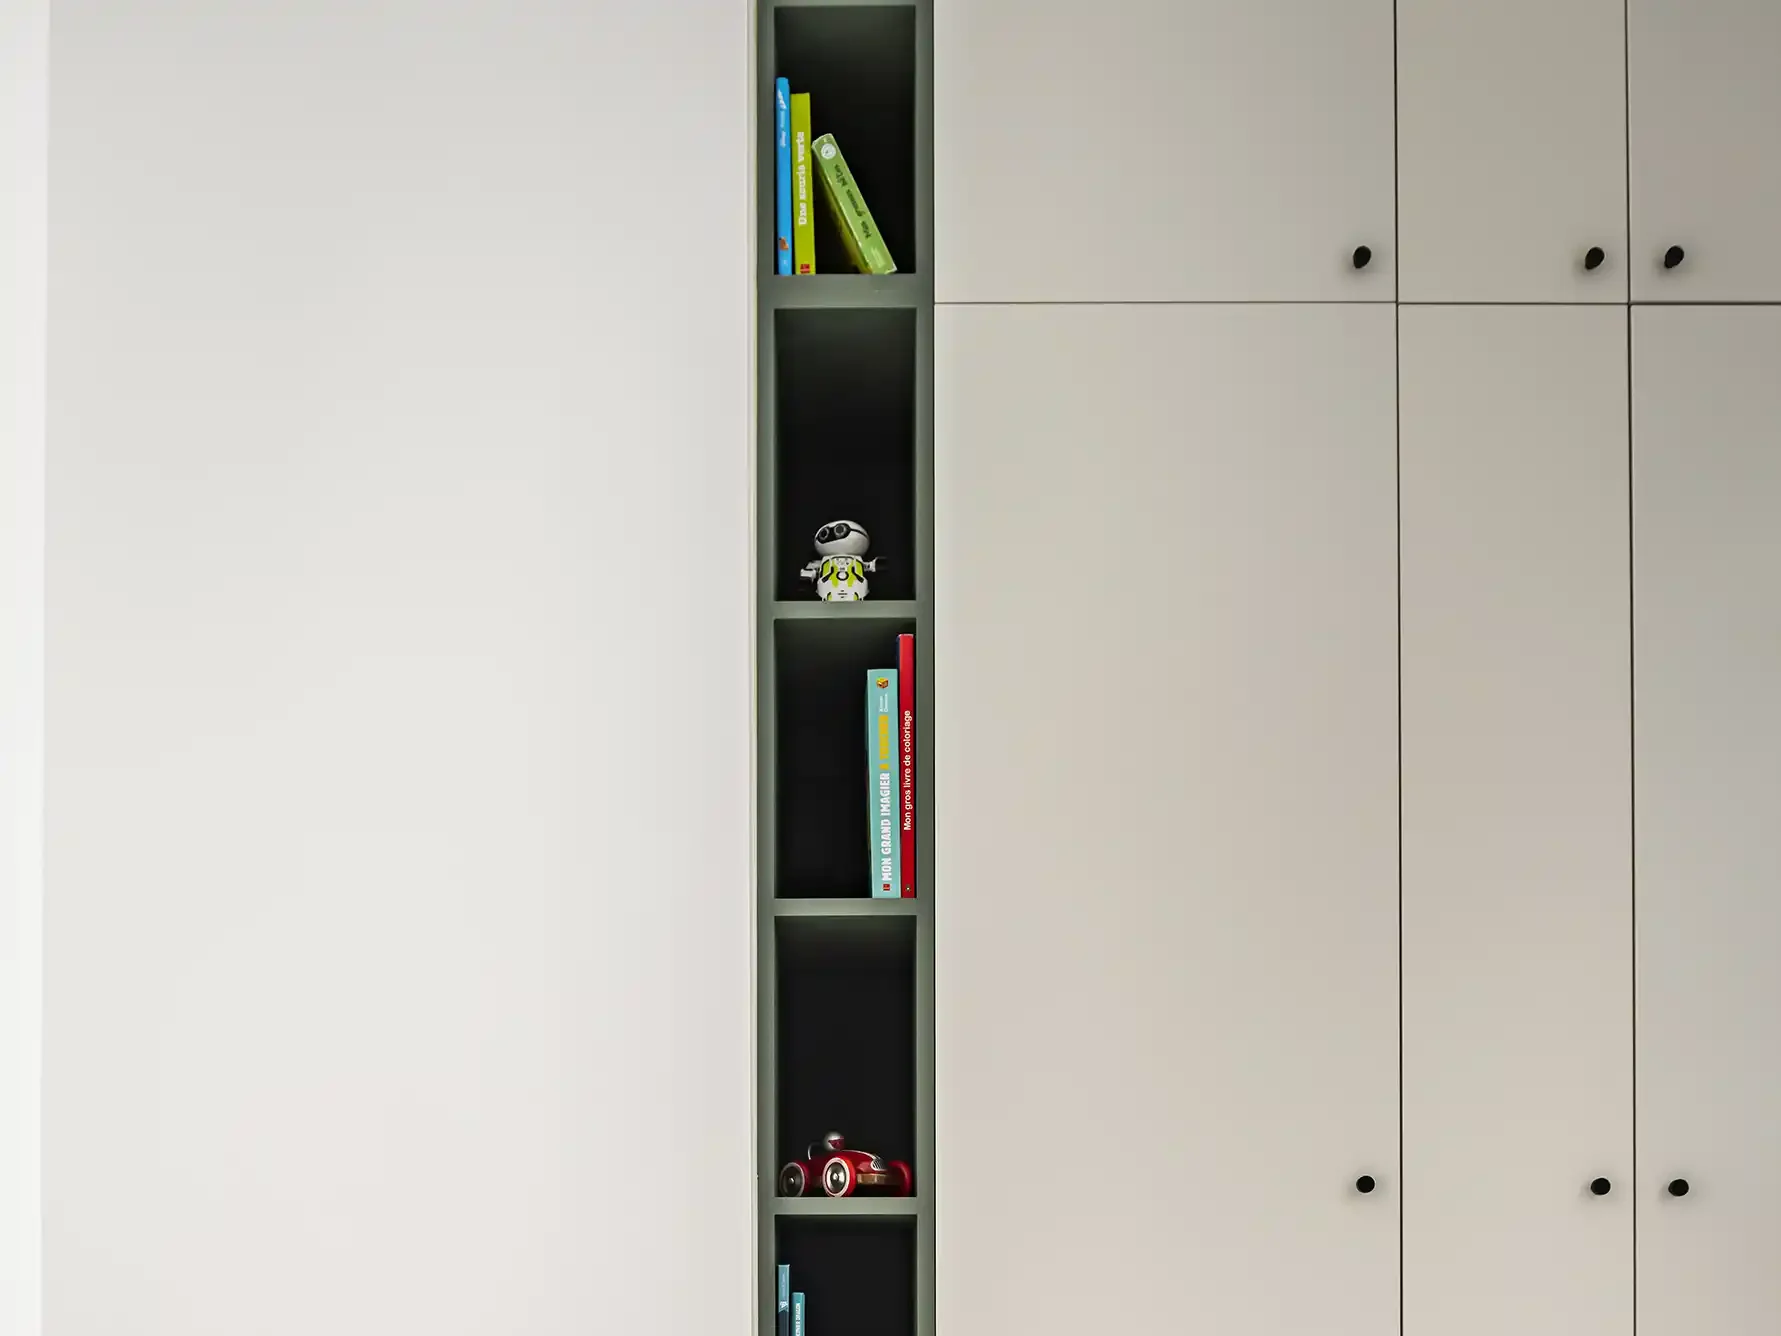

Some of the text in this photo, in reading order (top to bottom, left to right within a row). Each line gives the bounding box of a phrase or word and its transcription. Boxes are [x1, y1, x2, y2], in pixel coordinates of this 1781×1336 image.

[903, 710, 913, 831] Mon gros livre de coloriage
[880, 773, 891, 816] IMAGIER
[880, 819, 892, 855] GRAND
[881, 857, 892, 881] MON
